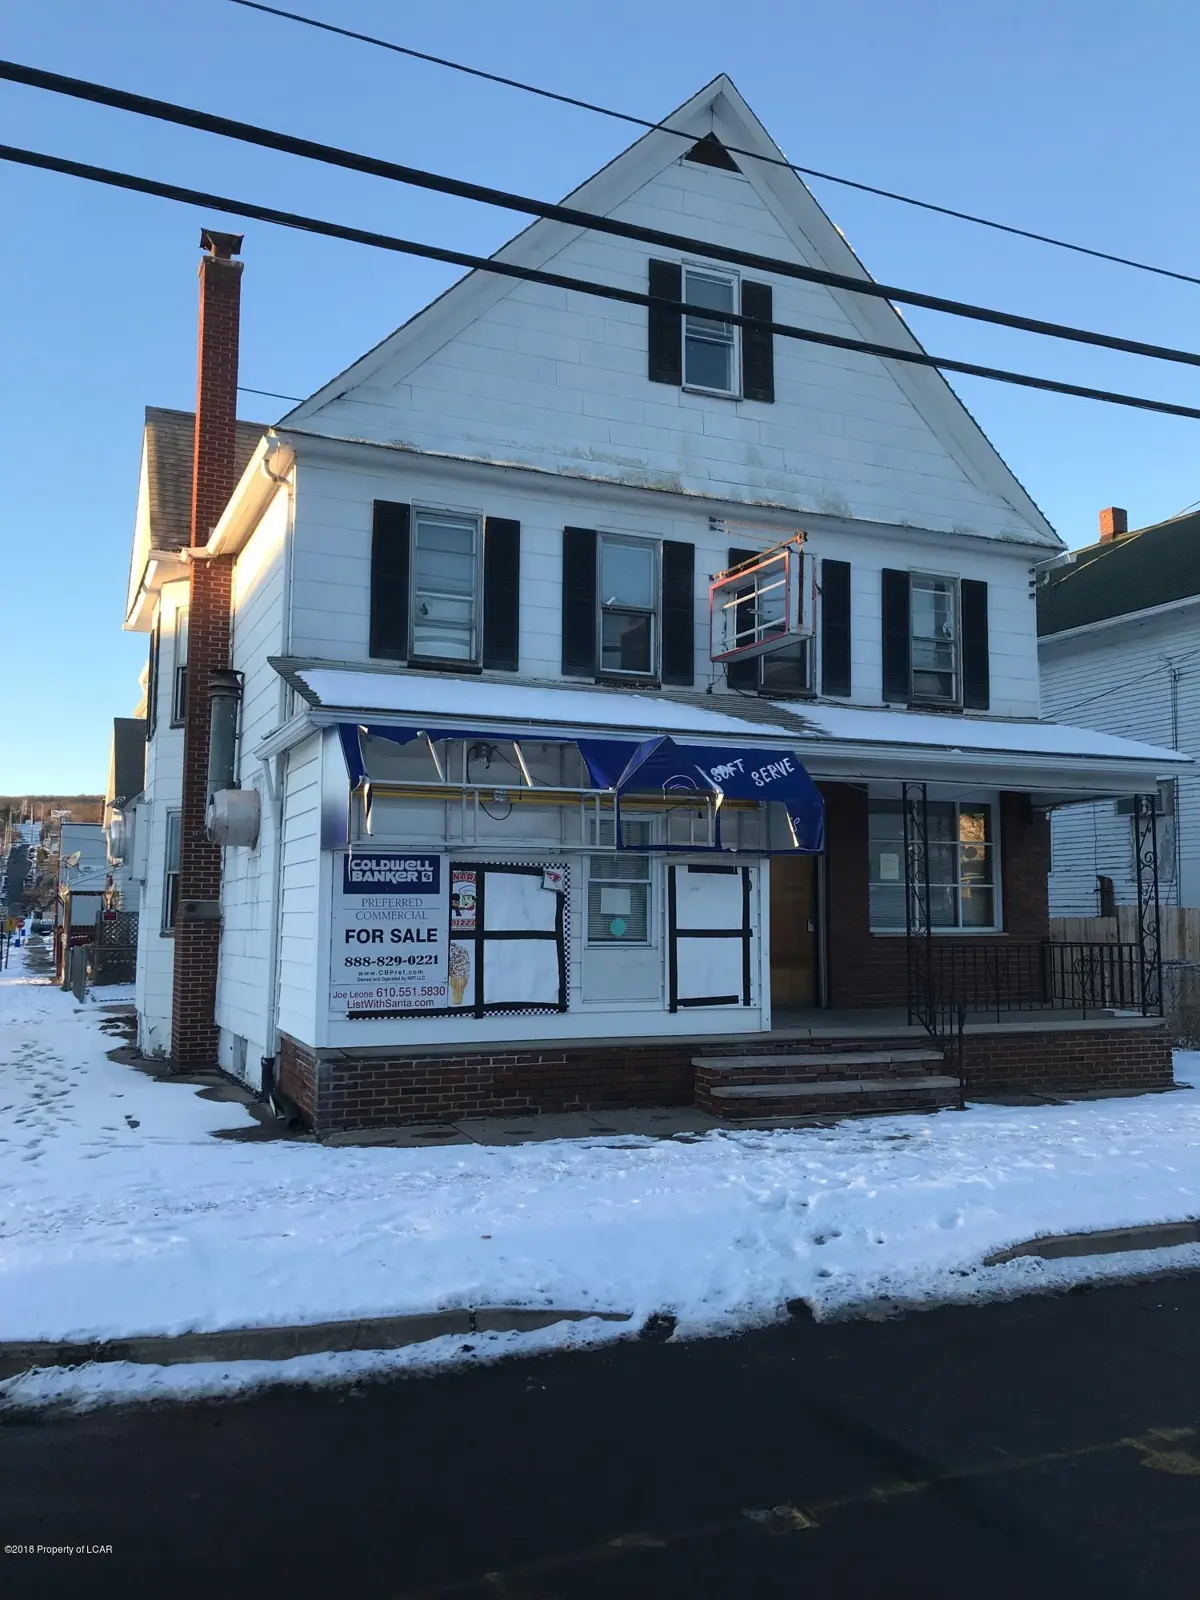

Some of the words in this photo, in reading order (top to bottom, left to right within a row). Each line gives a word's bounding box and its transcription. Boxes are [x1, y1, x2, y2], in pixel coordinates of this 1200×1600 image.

[710, 758, 744, 782] SOFT
[751, 757, 795, 787] SERVE
[351, 860, 434, 870] COLDWELL
[351, 871, 418, 884] BANKER
[361, 898, 423, 908] PREFERRED
[355, 911, 428, 920] COMMERCIAL
[345, 928, 384, 944] FOR
[390, 928, 438, 943] SALE
[344, 954, 439, 967] 888-829-0221
[333, 991, 347, 999] Joe
[349, 990, 374, 998] Leone
[376, 986, 446, 998] 610.551.5830
[347, 999, 434, 1009] ListWithSanta.com
